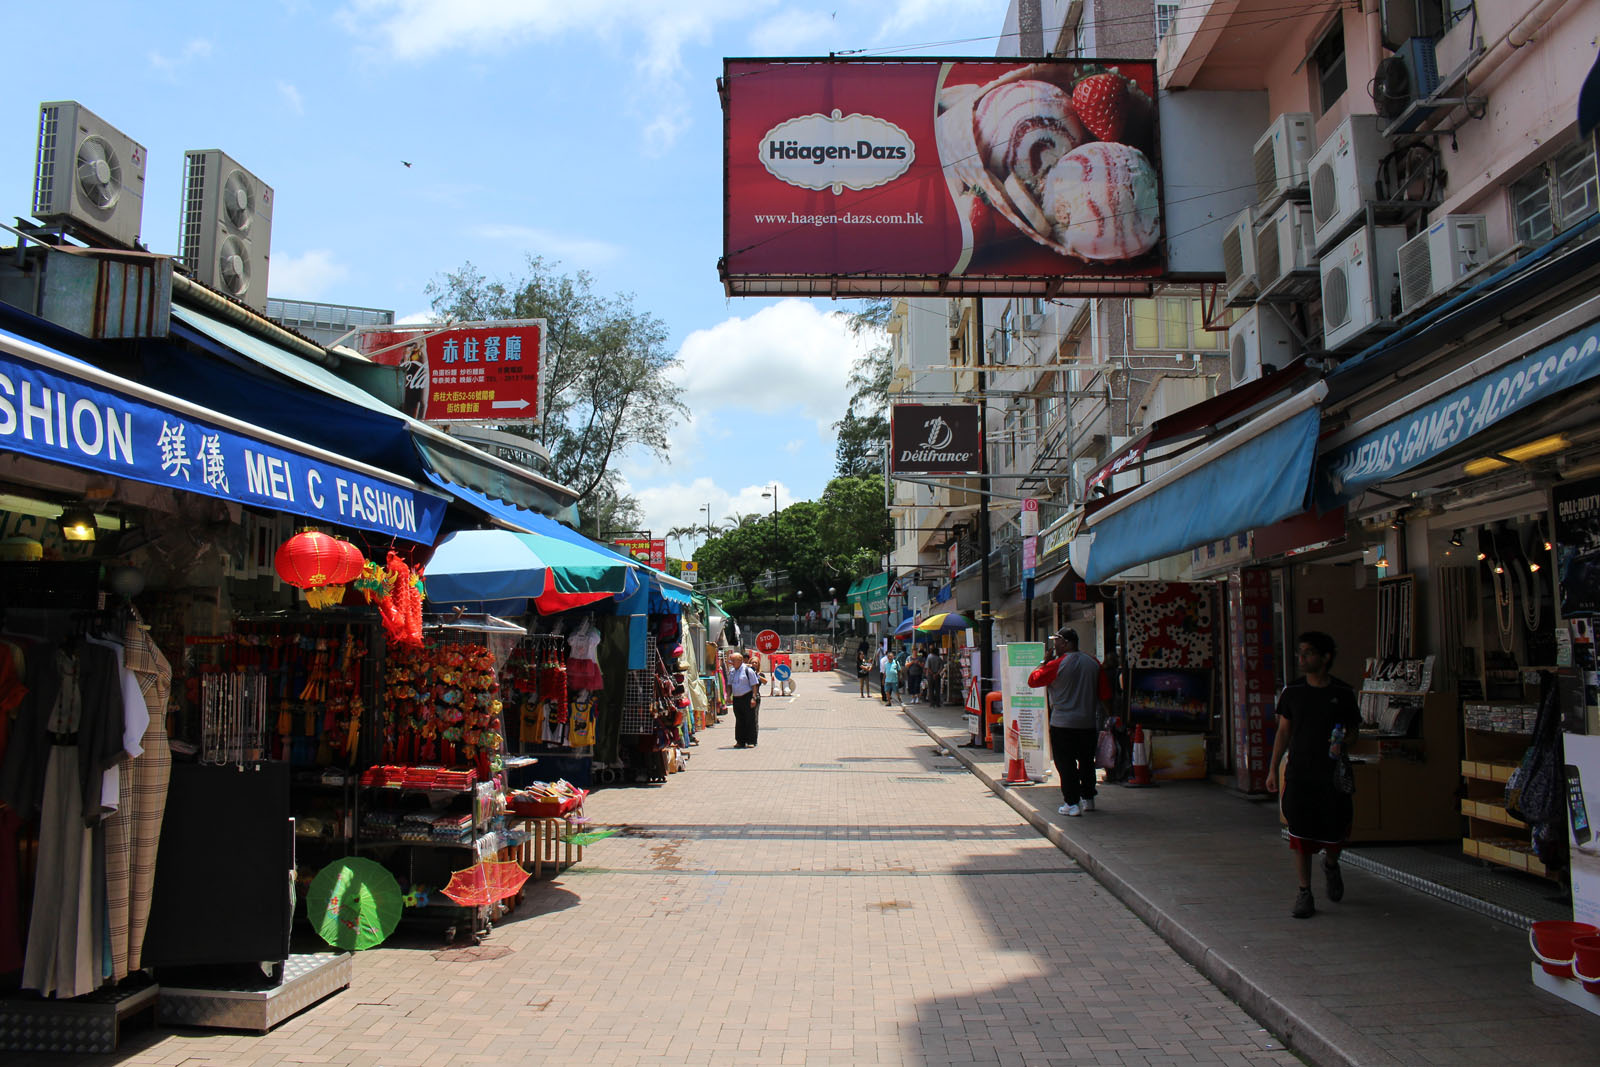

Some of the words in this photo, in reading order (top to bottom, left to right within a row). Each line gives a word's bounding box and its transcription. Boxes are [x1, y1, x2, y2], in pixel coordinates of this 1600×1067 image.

[769, 140, 907, 165] Häagen-Dazs
[754, 211, 924, 227] www.haagen-dazs.com.hk
[442, 335, 522, 364] 赤柱餐廳
[1401, 395, 1470, 464] GAMES
[900, 450, 970, 463] Délifrance
[244, 449, 295, 502] MEI
[307, 469, 325, 510] C
[336, 477, 417, 533] FASHION
[760, 634, 775, 642] STOP
[1244, 603, 1260, 672] MONEY
[1248, 678, 1264, 771] CHANGER
